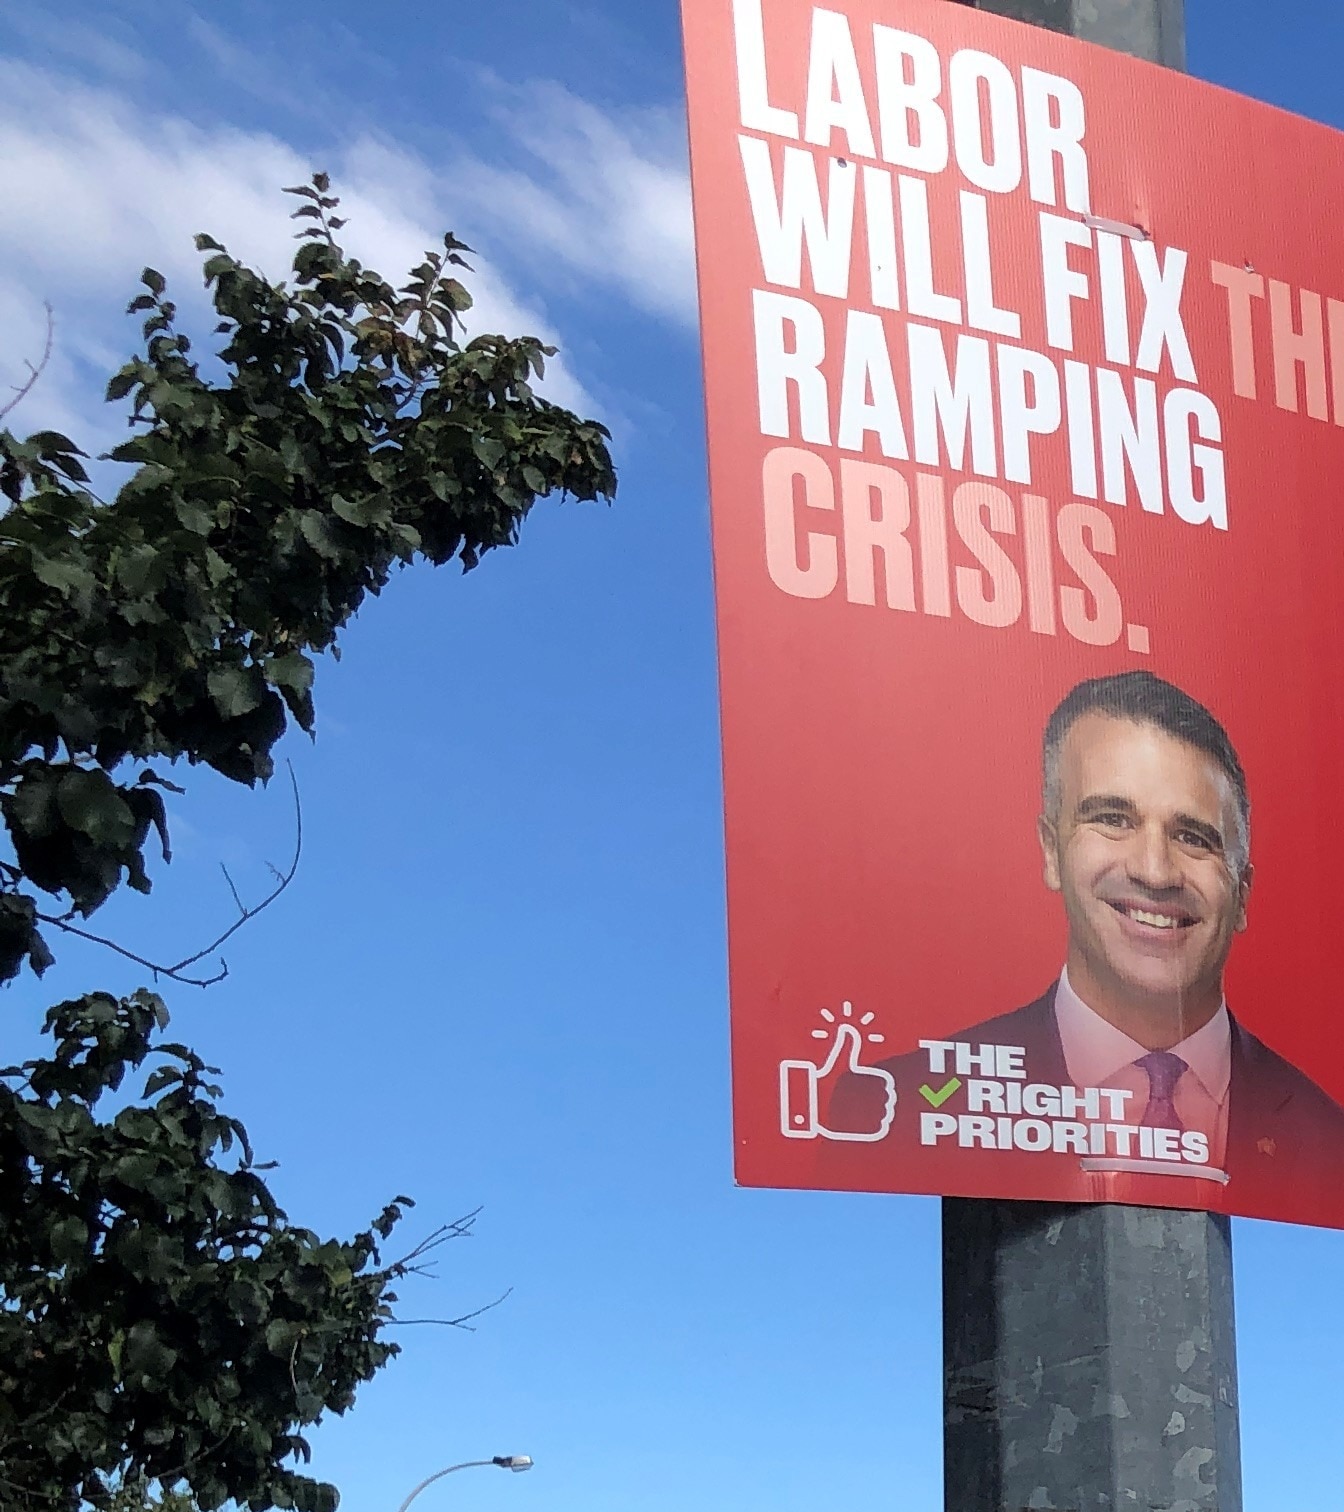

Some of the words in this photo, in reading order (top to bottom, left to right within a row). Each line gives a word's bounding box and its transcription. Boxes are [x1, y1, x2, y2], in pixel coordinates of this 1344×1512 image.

[733, 0, 1088, 213] LABOR
[737, 133, 1022, 341] WILL
[1038, 211, 1200, 385] FIX
[751, 288, 1229, 532] RAMPING
[760, 445, 1150, 655] CRISIS.
[918, 1038, 1028, 1080] THE
[919, 1111, 1210, 1164] PRIORITIES
[967, 1078, 1134, 1122] RIGHT
